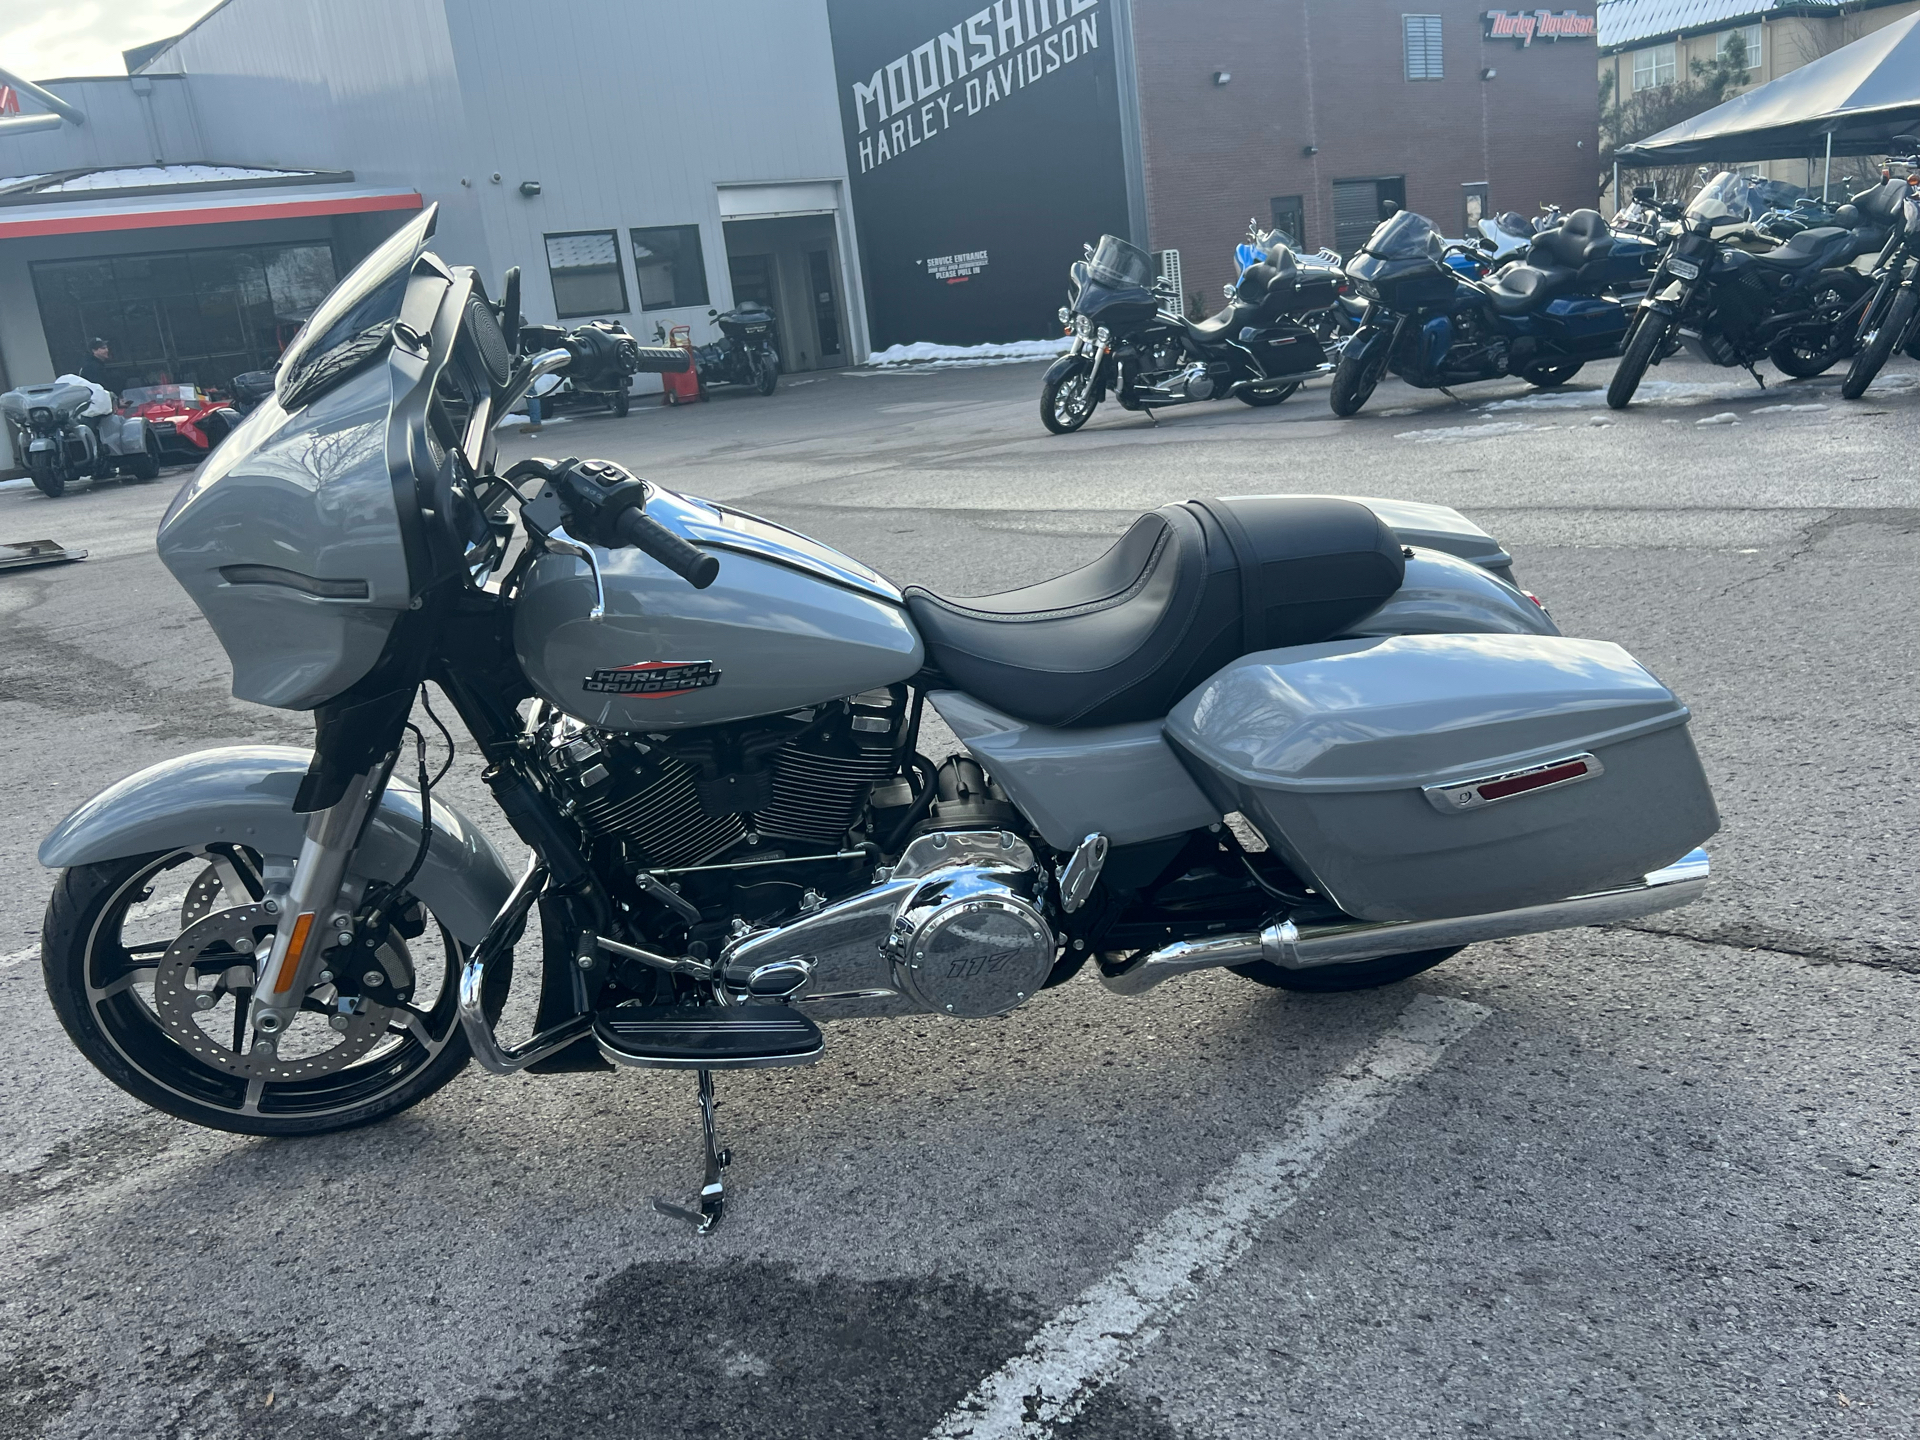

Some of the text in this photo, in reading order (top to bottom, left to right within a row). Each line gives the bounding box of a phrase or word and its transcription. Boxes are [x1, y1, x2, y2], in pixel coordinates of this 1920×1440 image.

[852, 0, 1098, 134] MOONSHIN
[858, 12, 1099, 174] HARLEY-DAVIDSON
[926, 255, 953, 267] SERVICE
[954, 250, 988, 262] ENTRANCE
[935, 270, 957, 279] PLEASE
[958, 268, 972, 276] PULL
[587, 675, 716, 691] DAVIDSON
[947, 946, 1021, 978] 117
